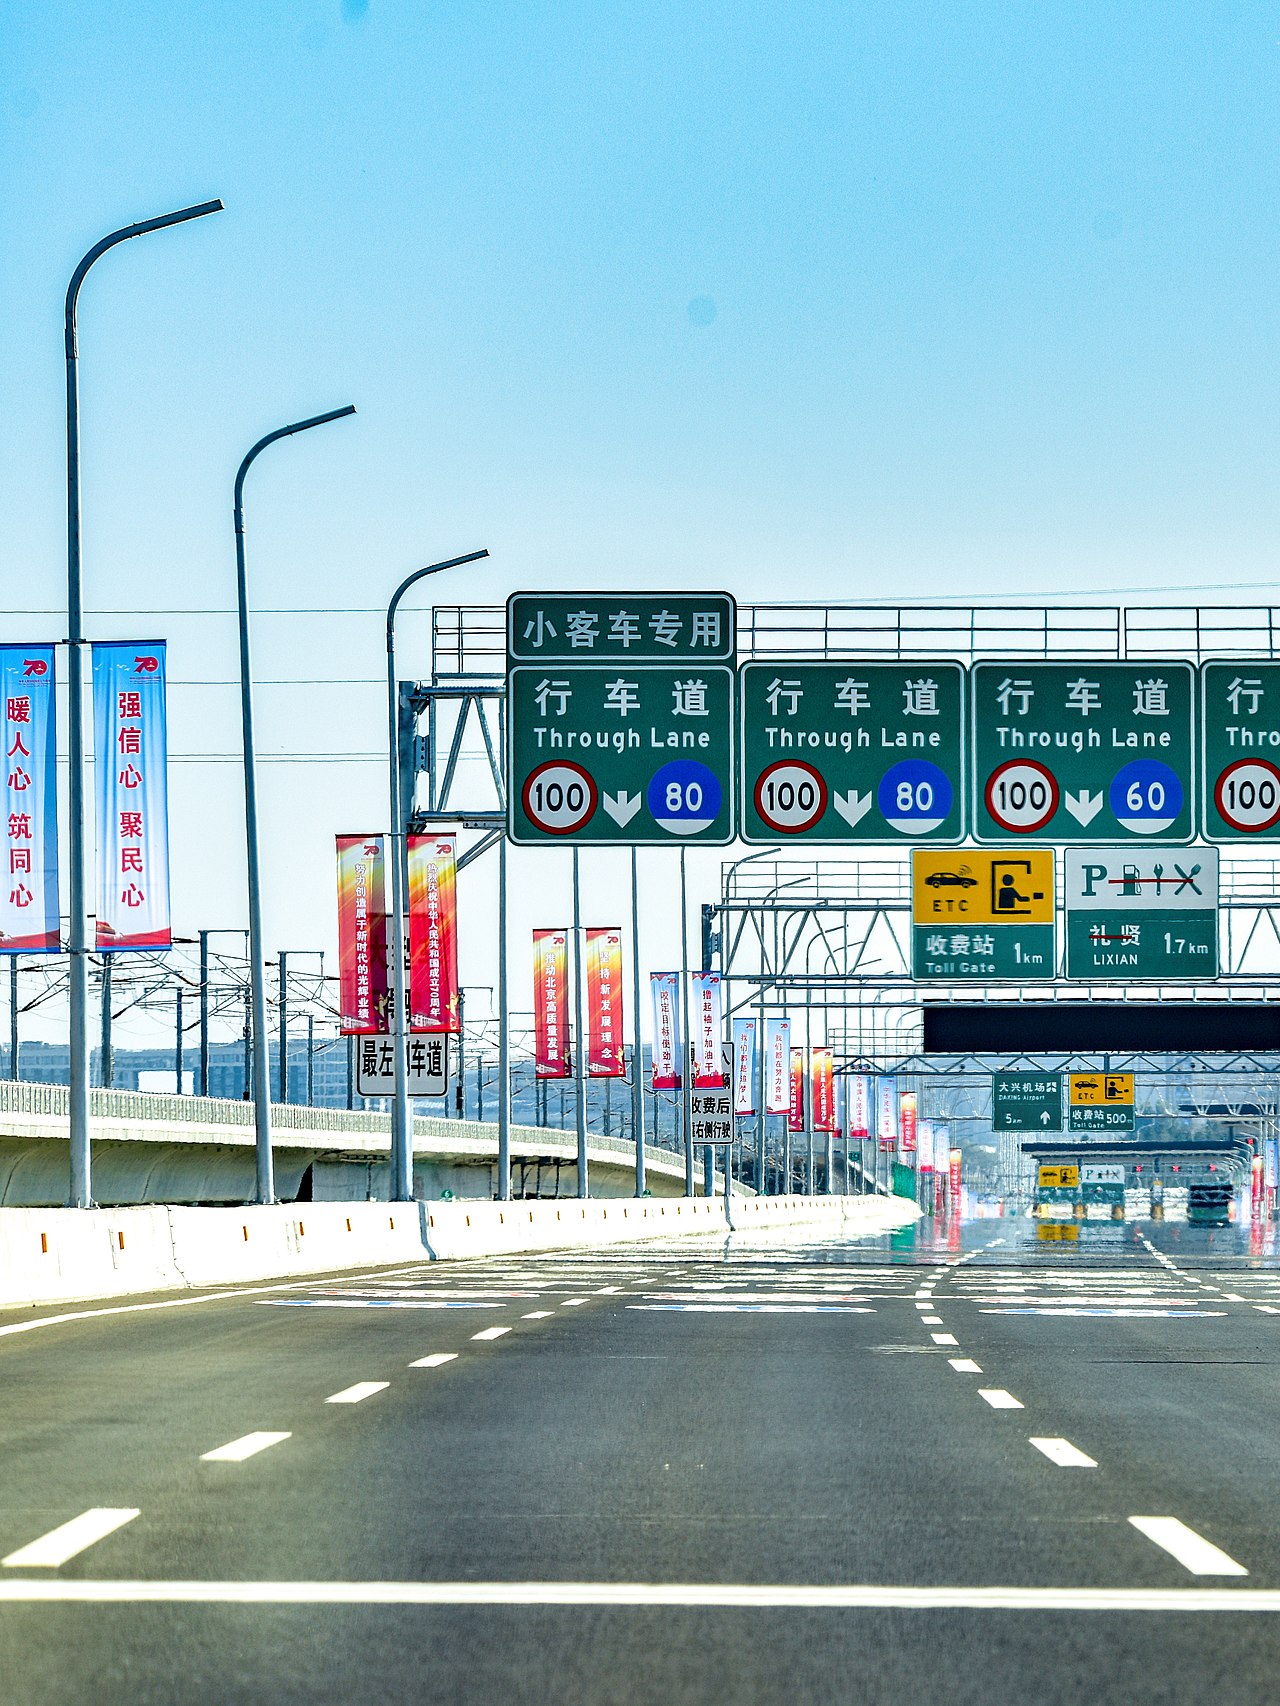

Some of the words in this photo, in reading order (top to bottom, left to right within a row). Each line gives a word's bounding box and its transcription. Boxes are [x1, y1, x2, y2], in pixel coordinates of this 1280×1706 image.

[523, 610, 721, 648] 小客车专用
[534, 678, 709, 716] 行车道
[766, 678, 940, 716] 行车道
[996, 678, 1171, 716] 行车道
[533, 728, 640, 753] Through
[651, 728, 710, 748] Lane
[765, 728, 872, 753] Through
[882, 728, 941, 748] Lane
[995, 728, 1101, 753] Through
[1111, 728, 1171, 748] Lane
[535, 783, 585, 812] 100
[666, 783, 703, 811] 80
[766, 783, 814, 812] 100
[896, 783, 934, 811] 80
[998, 783, 1046, 812] 100
[1126, 783, 1165, 811] 60
[1228, 781, 1276, 810] 100
[933, 899, 969, 913] ETC
[355, 863, 370, 1019] 努力创造属于新时代的光辉业绩
[926, 933, 996, 957] 收费站
[925, 961, 955, 974] Toll
[959, 961, 996, 974] Gate
[1093, 953, 1139, 966] LIXIAN
[545, 952, 559, 1061] 推动北京高质量发展
[600, 952, 613, 1059] 坚持新发展理念
[362, 1039, 443, 1078] 最左车道
[999, 1082, 1045, 1093] 大兴机场
[1078, 1092, 1095, 1100] ETC
[1072, 1109, 1105, 1120] 收费站
[692, 1121, 731, 1139] 右侧行驶
